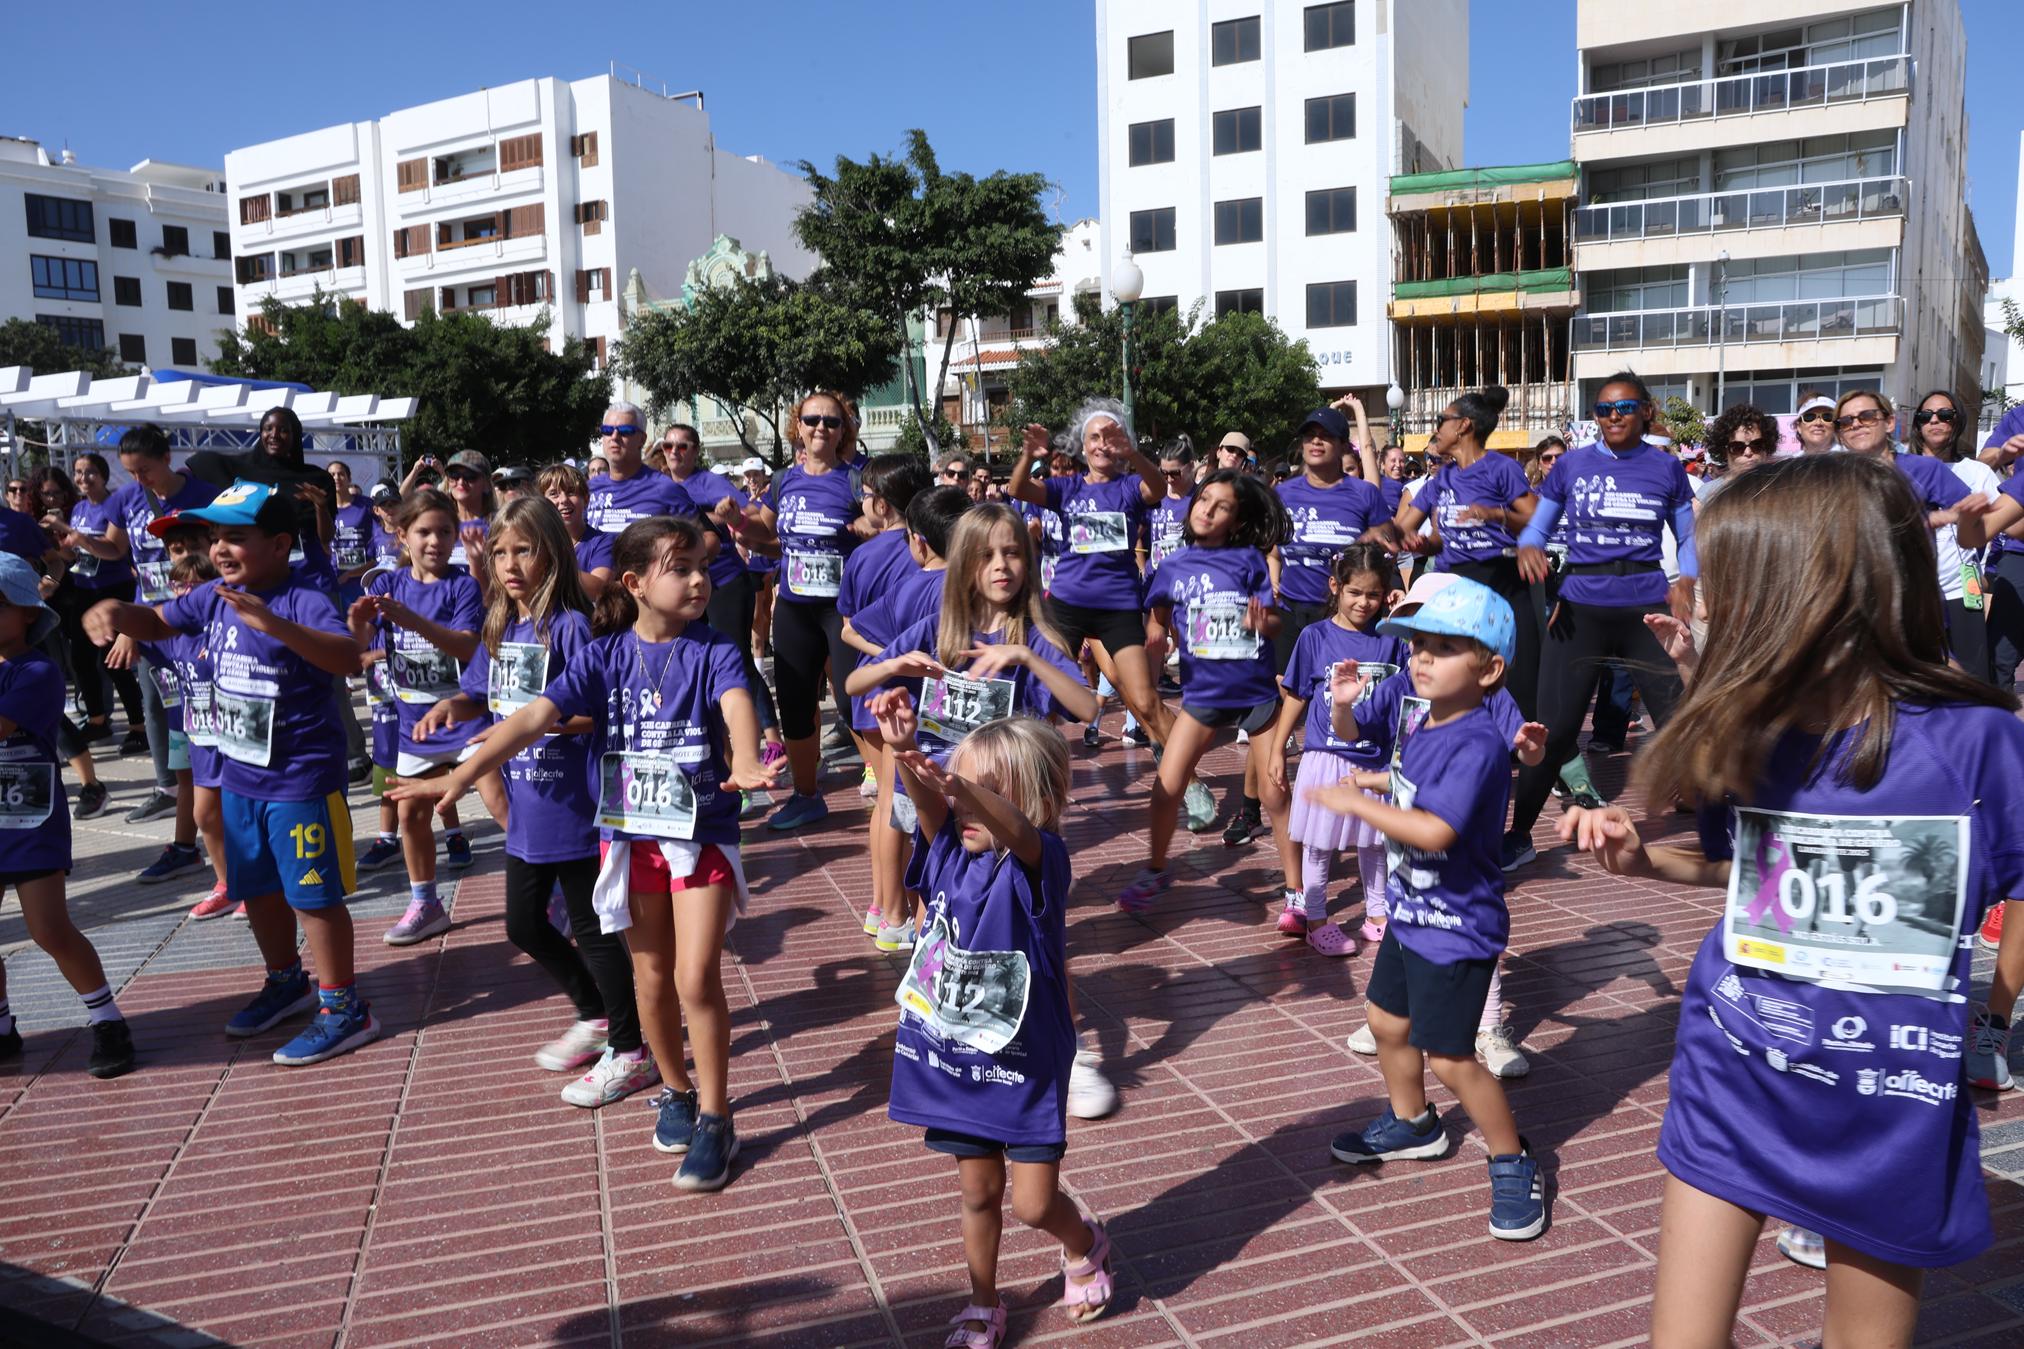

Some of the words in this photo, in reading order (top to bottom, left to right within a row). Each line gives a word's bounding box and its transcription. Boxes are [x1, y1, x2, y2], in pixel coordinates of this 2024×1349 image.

[802, 567, 828, 582] 016
[1205, 620, 1241, 641] 016
[405, 667, 440, 685] 016
[942, 694, 982, 724] 112
[216, 710, 246, 739] 016
[640, 721, 655, 730] XIII
[655, 720, 692, 729] CARRERA
[641, 729, 672, 739] CONTRA
[641, 739, 653, 748] DE
[626, 779, 672, 809] 016
[290, 823, 325, 859] 19
[1778, 868, 1898, 925] 016
